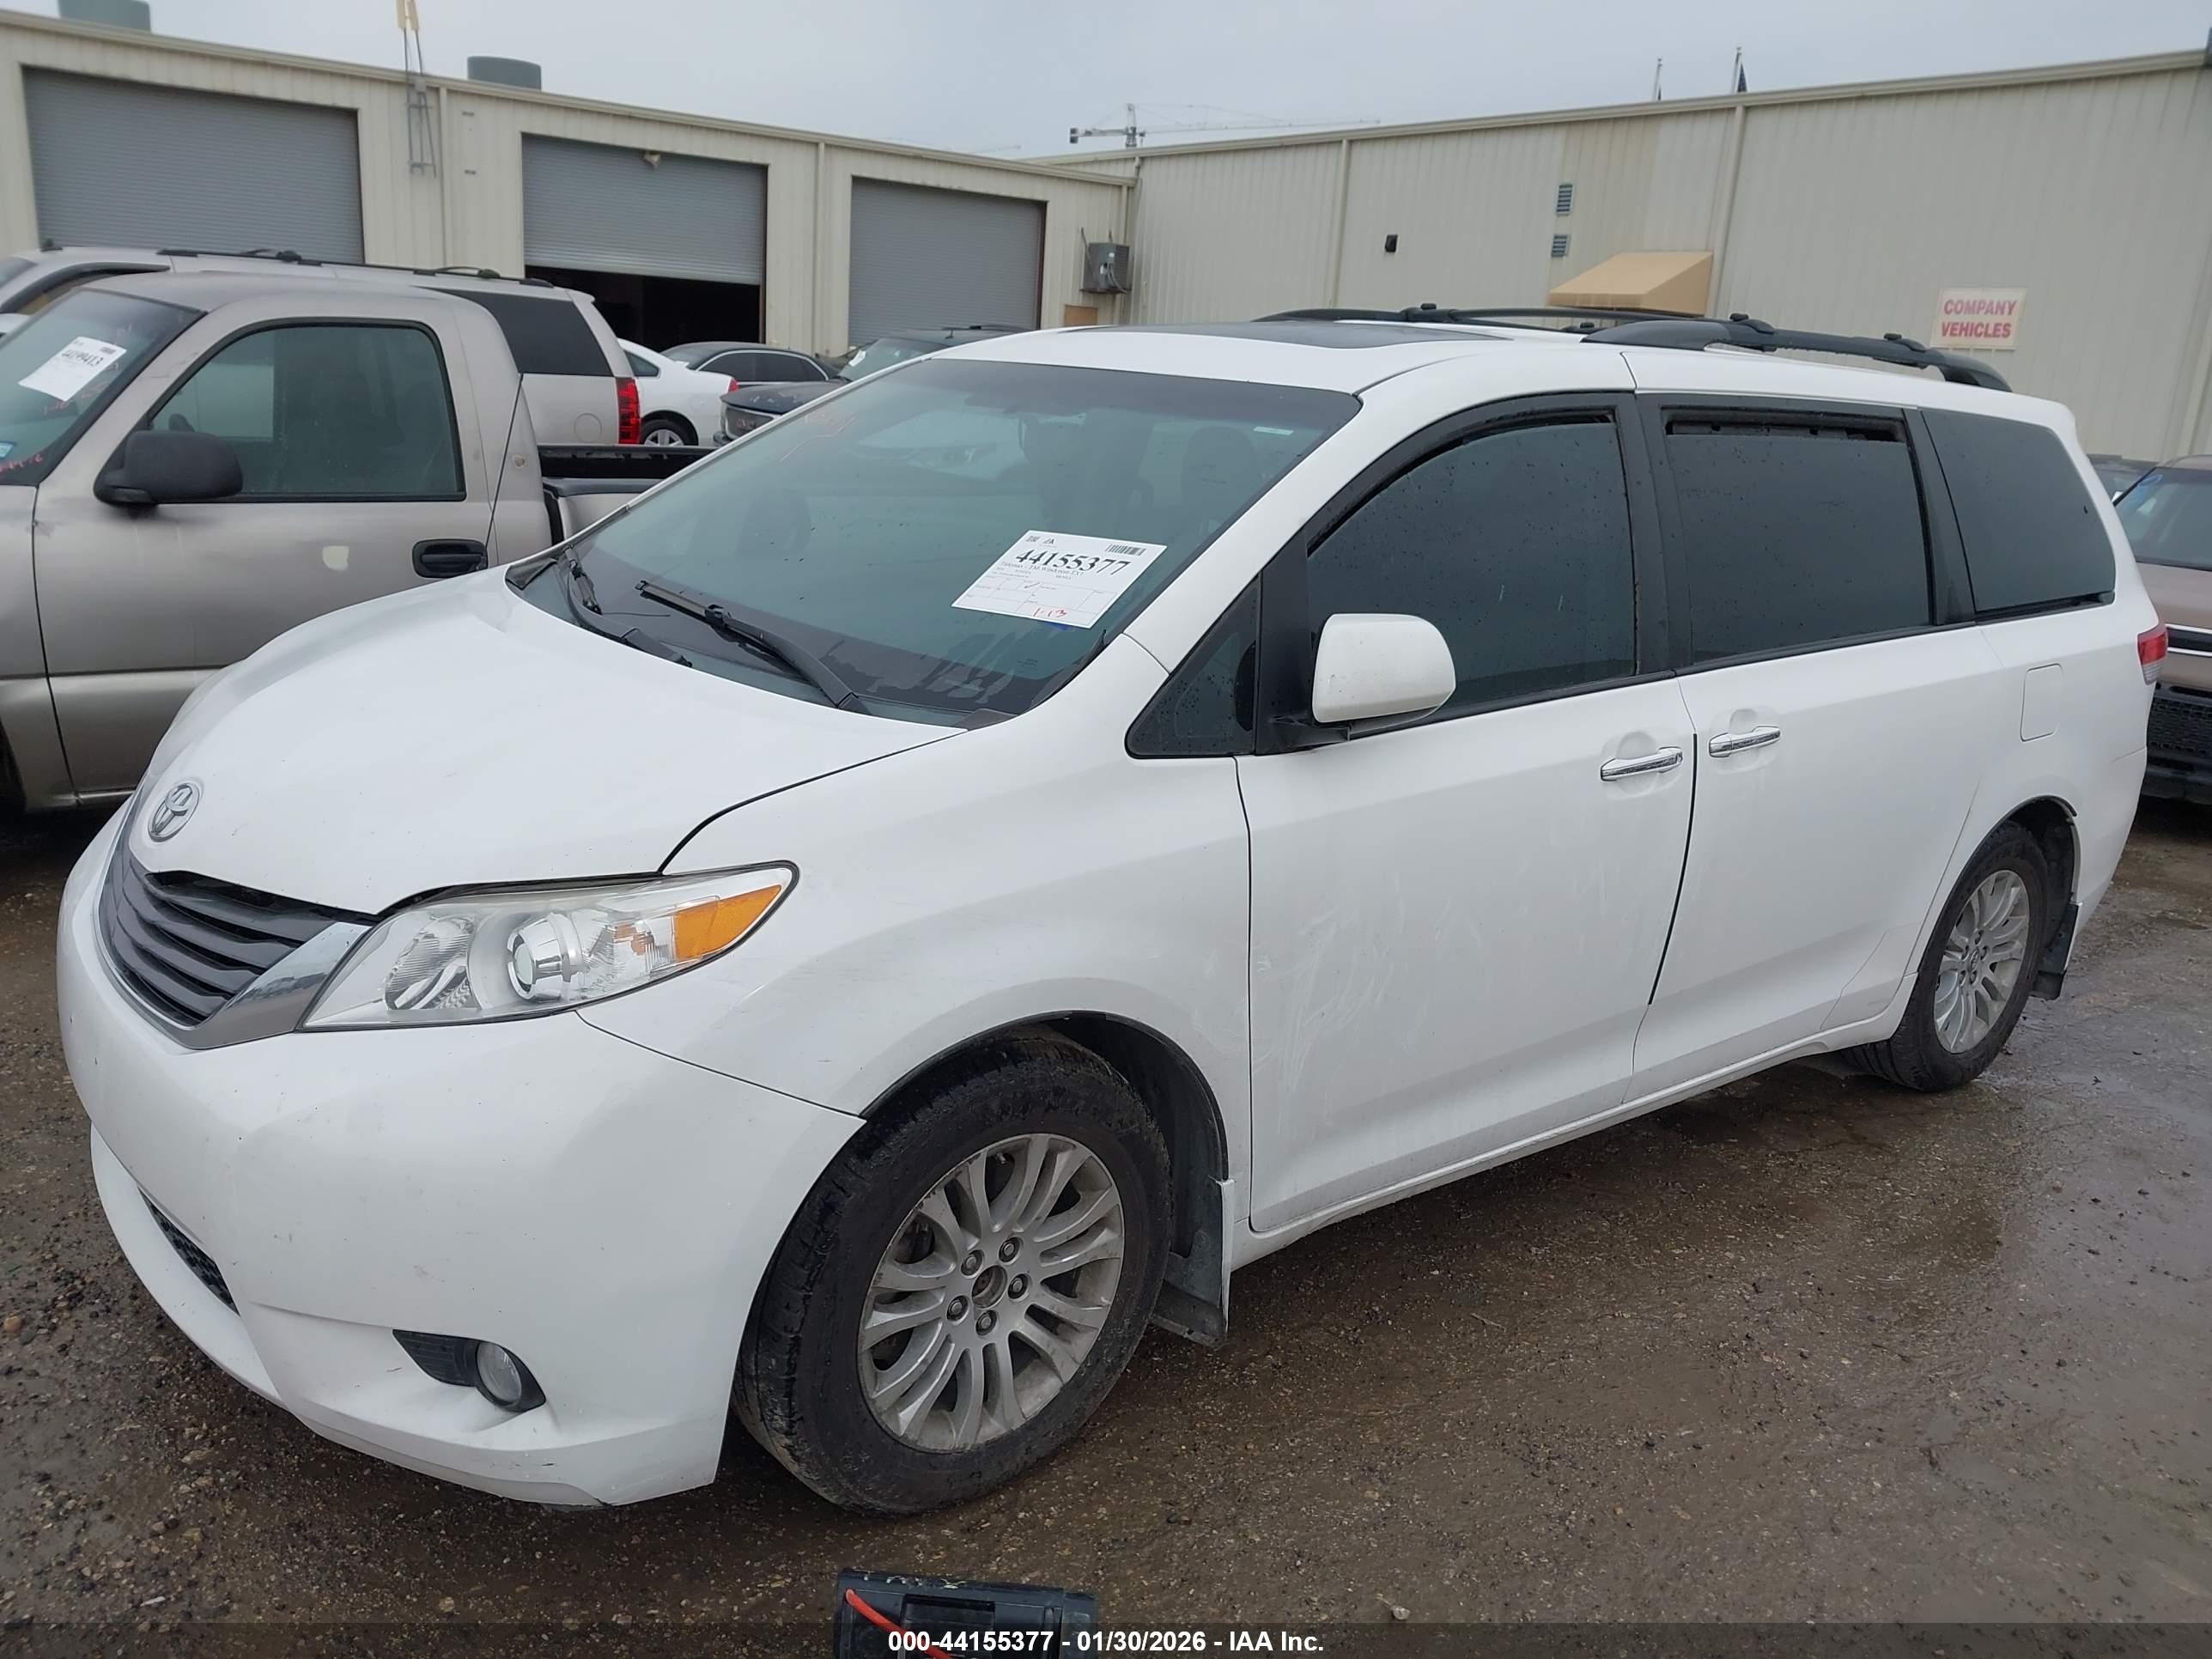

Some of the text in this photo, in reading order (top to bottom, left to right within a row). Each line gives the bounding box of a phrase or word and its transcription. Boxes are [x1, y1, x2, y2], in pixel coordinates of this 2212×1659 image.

[1943, 299, 2017, 316] COMPANY
[1942, 322, 2011, 338] VEHICLES
[1015, 550, 1132, 575] 44155377
